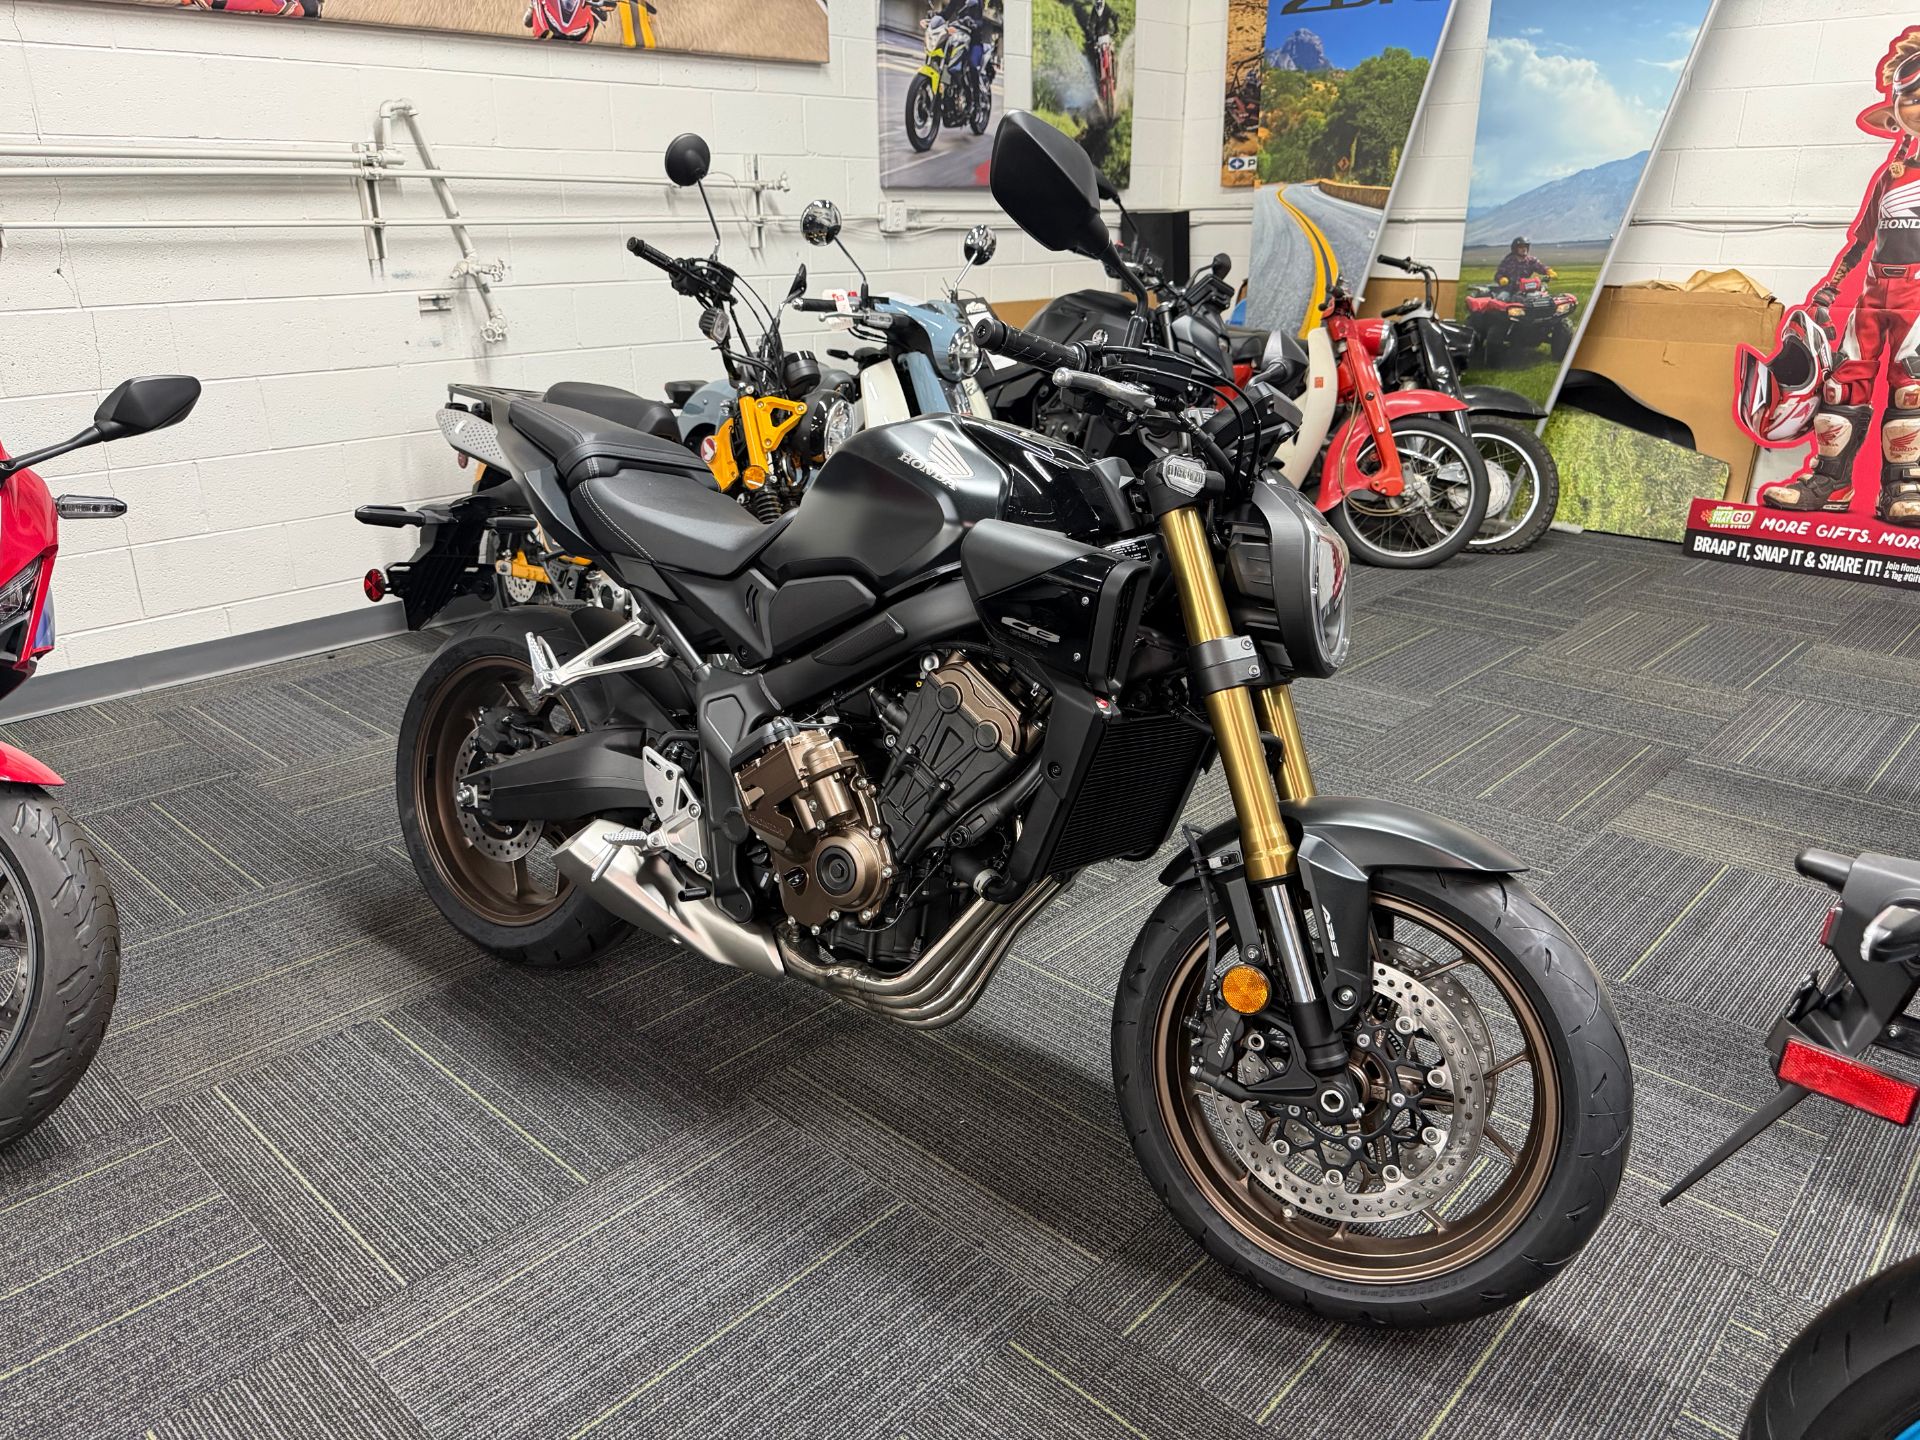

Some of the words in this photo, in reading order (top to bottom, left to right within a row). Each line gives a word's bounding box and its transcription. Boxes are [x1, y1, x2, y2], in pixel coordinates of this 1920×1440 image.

[897, 452, 959, 491] HONDA
[1732, 512, 1752, 523] GO
[1760, 517, 1811, 535] MORE
[1815, 524, 1872, 544] GIFTS.
[1877, 531, 1920, 550] MOR
[1693, 535, 1737, 556] BRAAP
[1736, 541, 1752, 562] IT,
[1753, 544, 1789, 564] SNAP
[1789, 548, 1805, 566] IT
[1803, 551, 1816, 568] &
[1817, 553, 1864, 575] SHARE
[1863, 559, 1883, 578] IT!
[1885, 560, 1900, 571] Join
[1883, 569, 1890, 579] &
[1891, 570, 1903, 582] Tag
[1001, 616, 1061, 643] CB
[1321, 903, 1340, 958] ABS
